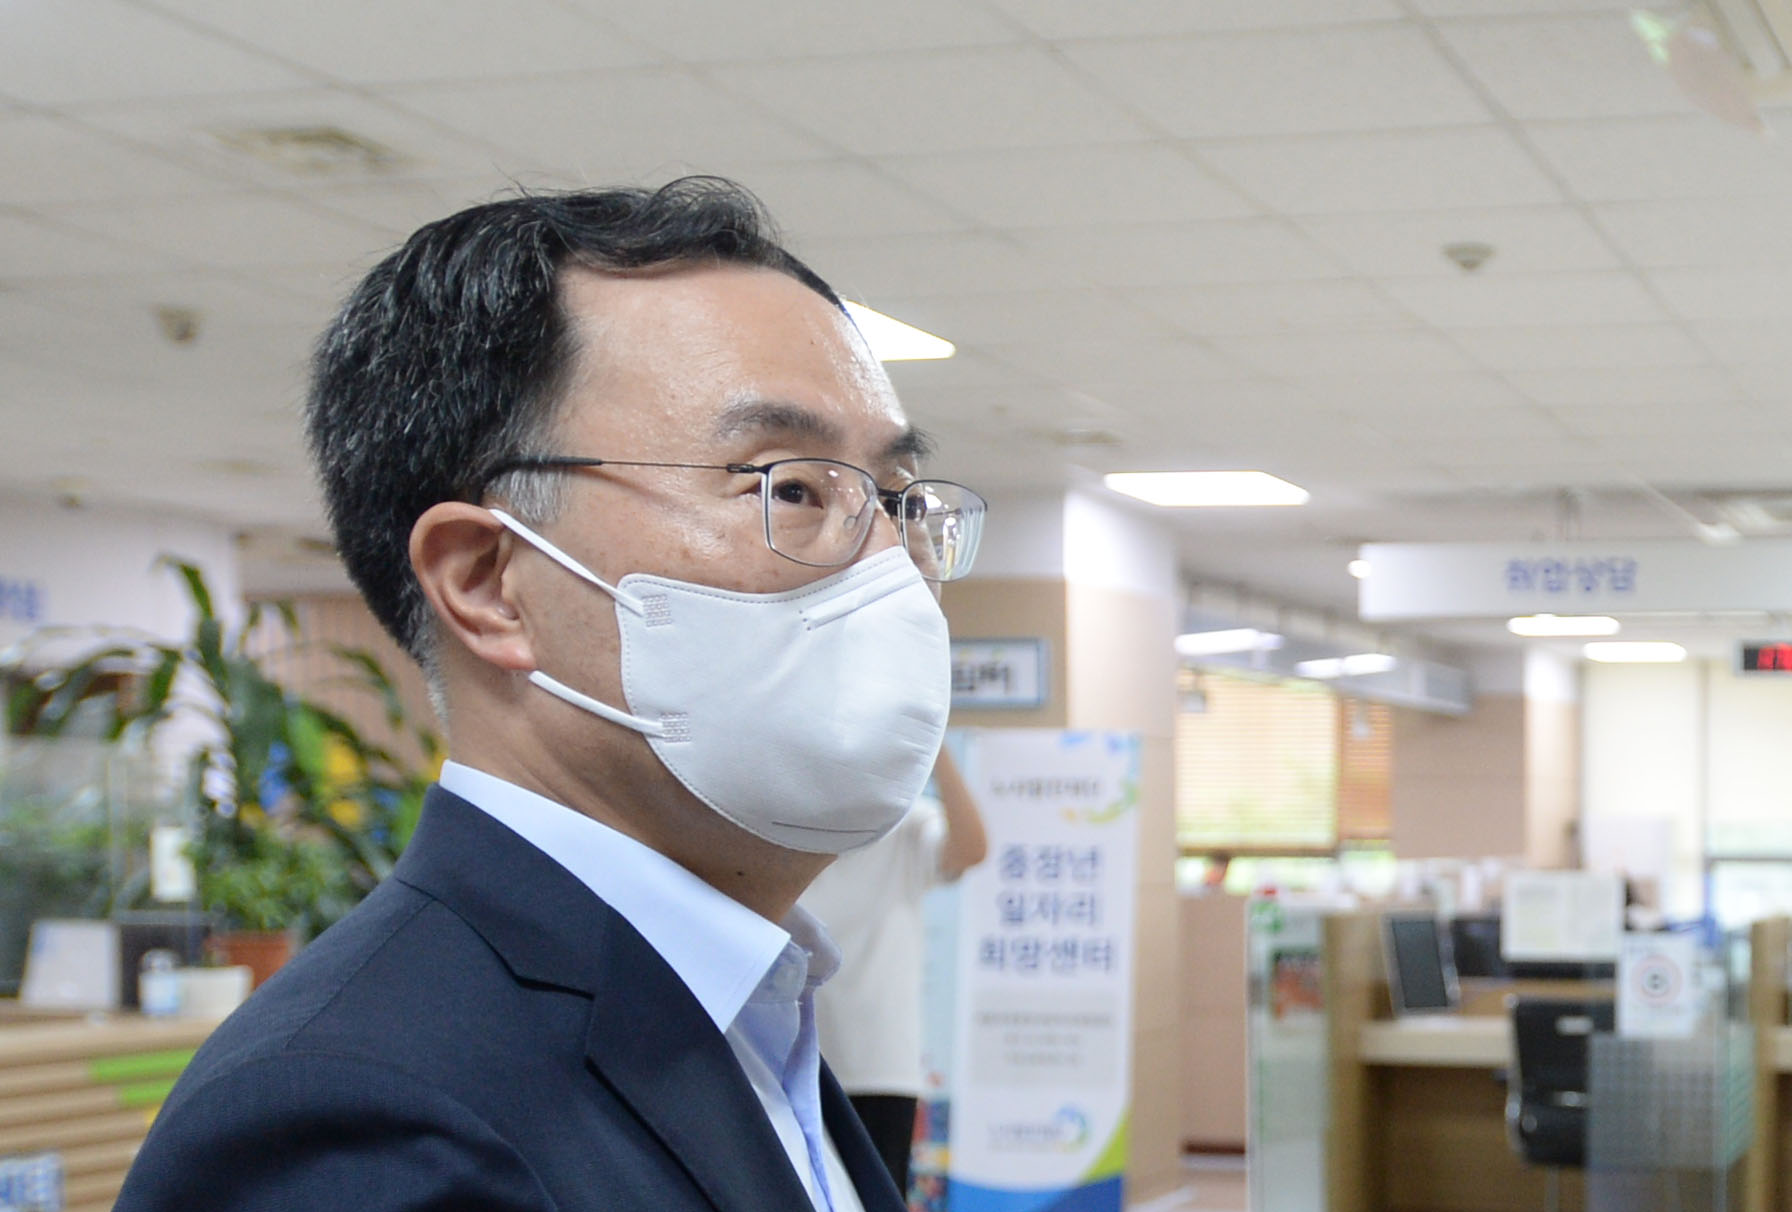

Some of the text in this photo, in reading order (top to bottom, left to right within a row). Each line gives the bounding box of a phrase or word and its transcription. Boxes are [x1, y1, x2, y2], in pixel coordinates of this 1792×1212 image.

[1505, 556, 1637, 593] 취업상담
[1000, 845, 1101, 883] 중장년
[997, 891, 1099, 929] 일자리
[979, 936, 1113, 973] 희망센터
